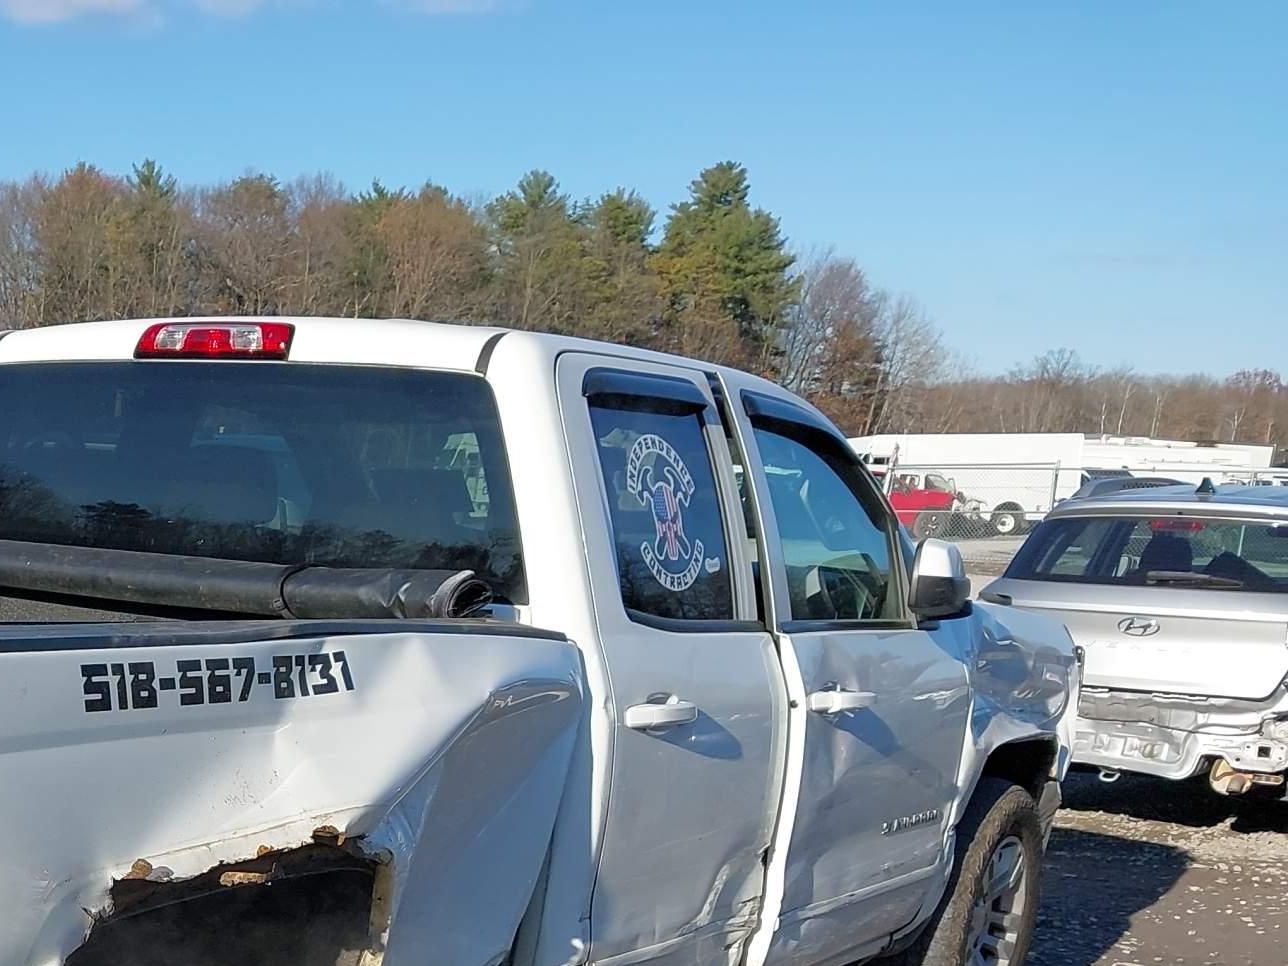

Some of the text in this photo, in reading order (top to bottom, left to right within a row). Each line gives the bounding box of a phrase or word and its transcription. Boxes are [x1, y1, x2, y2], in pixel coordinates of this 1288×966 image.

[628, 434, 694, 493] INDEPENDENCE
[642, 543, 703, 589] CONTRACTING
[80, 650, 355, 712] 518-567-8131
